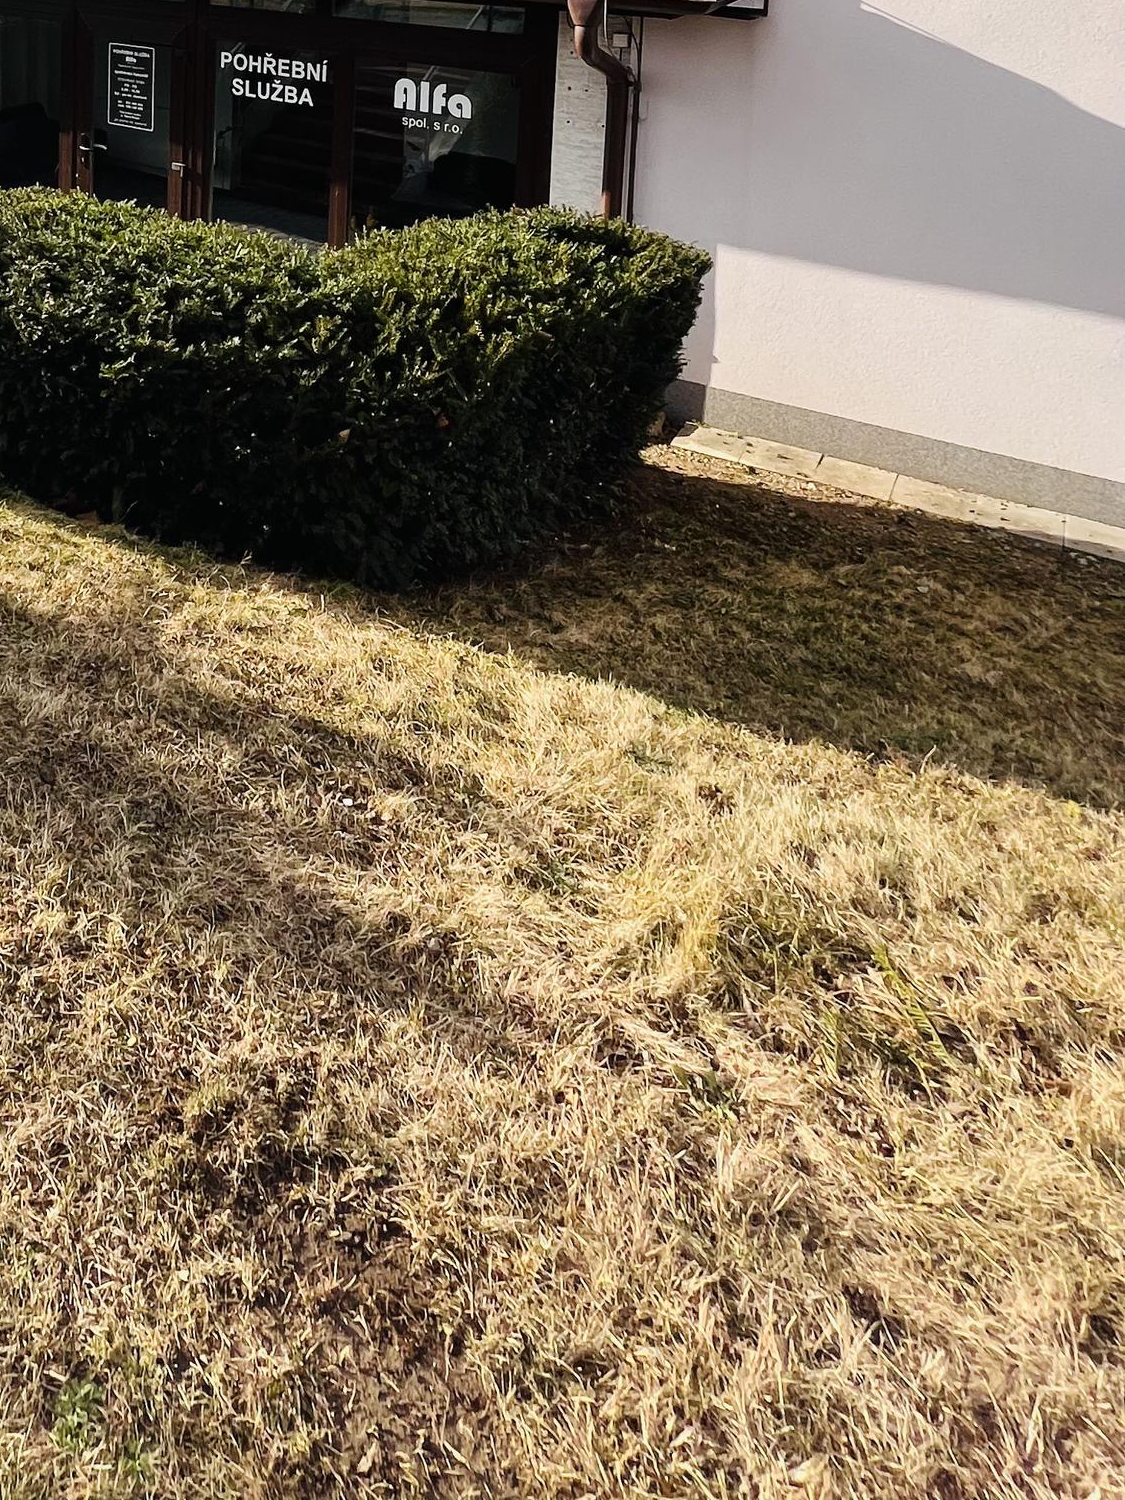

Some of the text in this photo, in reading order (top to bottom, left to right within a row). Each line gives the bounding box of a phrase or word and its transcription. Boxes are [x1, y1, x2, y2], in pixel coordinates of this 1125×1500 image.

[220, 51, 328, 82] POHŘEBNÍ
[231, 78, 314, 107] SLUŽBA
[393, 78, 473, 119] Alfa
[402, 116, 463, 134] spol. s r.o.
